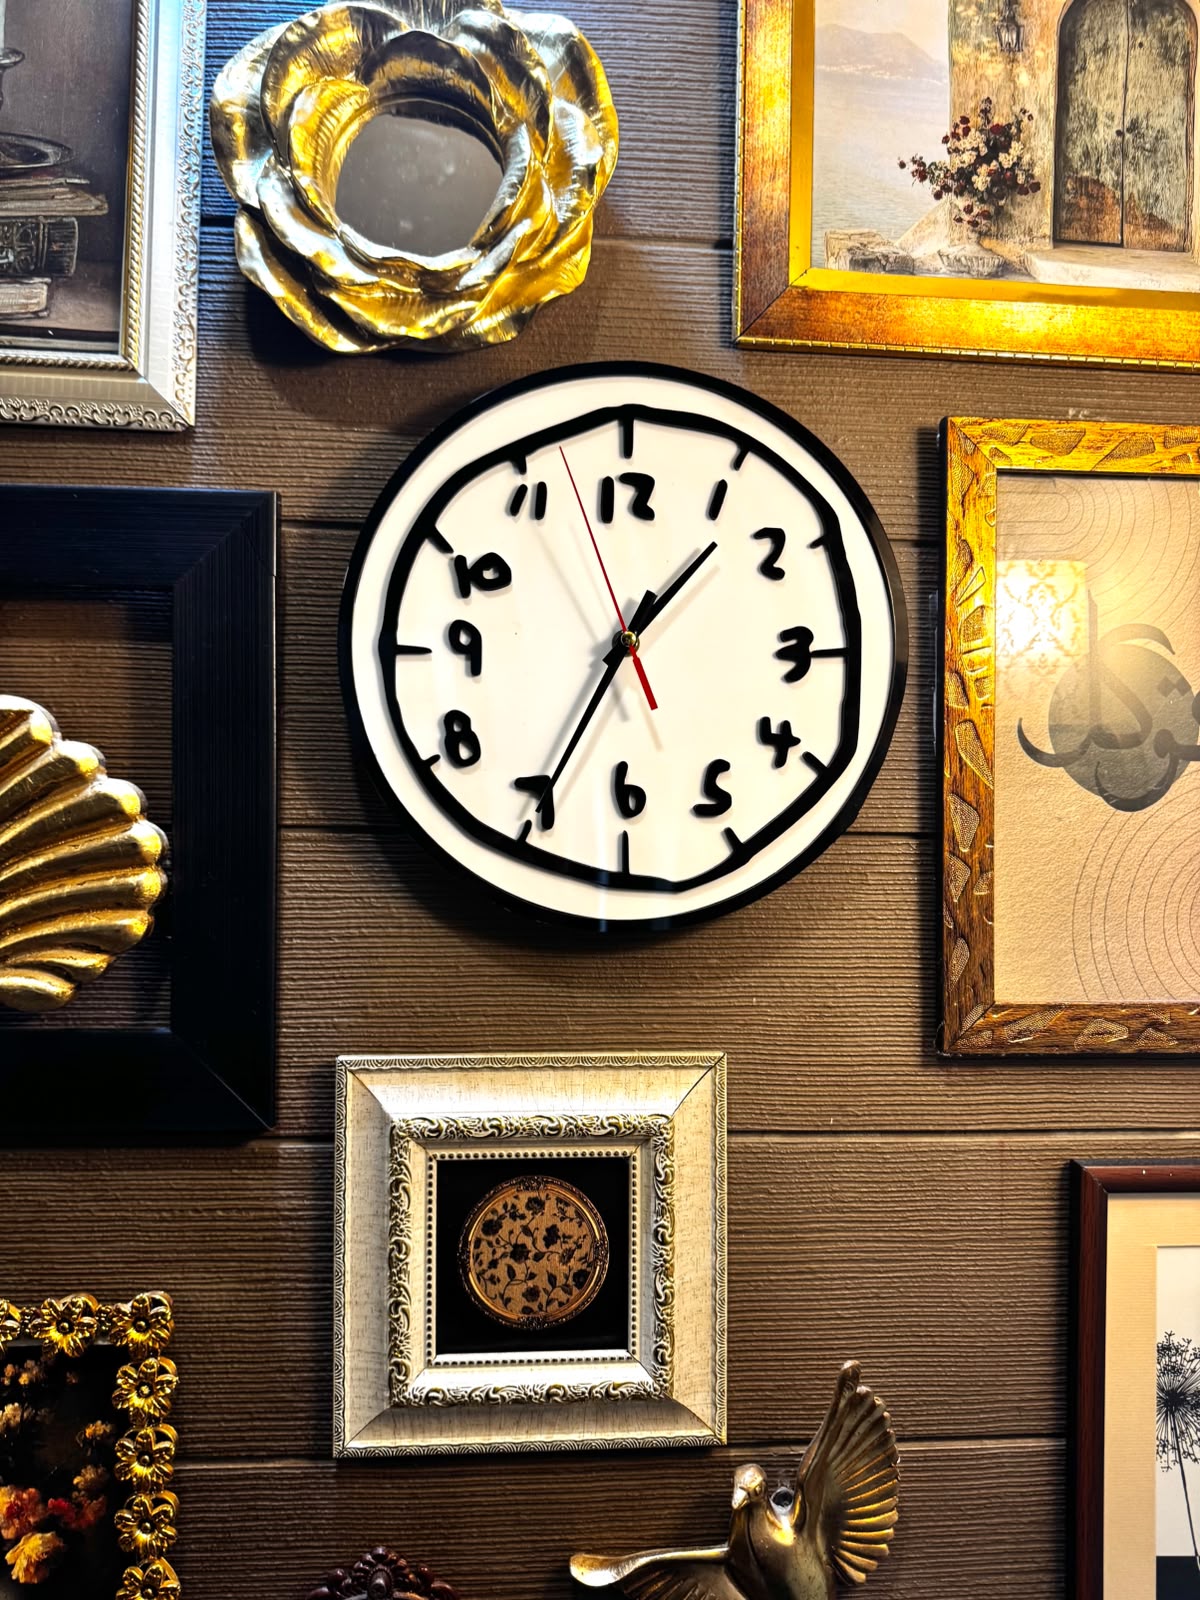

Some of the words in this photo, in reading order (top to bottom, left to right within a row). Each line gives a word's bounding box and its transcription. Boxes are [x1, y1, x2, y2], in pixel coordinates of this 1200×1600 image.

[508, 481, 548, 521] 11
[600, 472, 655, 523] 12
[707, 478, 728, 521] 1
[452, 552, 512, 598] 10
[752, 527, 786, 581] 2
[447, 619, 482, 677] 9
[775, 625, 814, 683] 3
[443, 709, 481, 768] 8
[758, 716, 802, 769] 4
[514, 774, 555, 830] 7
[613, 761, 647, 819] 6
[693, 759, 732, 818] 5
